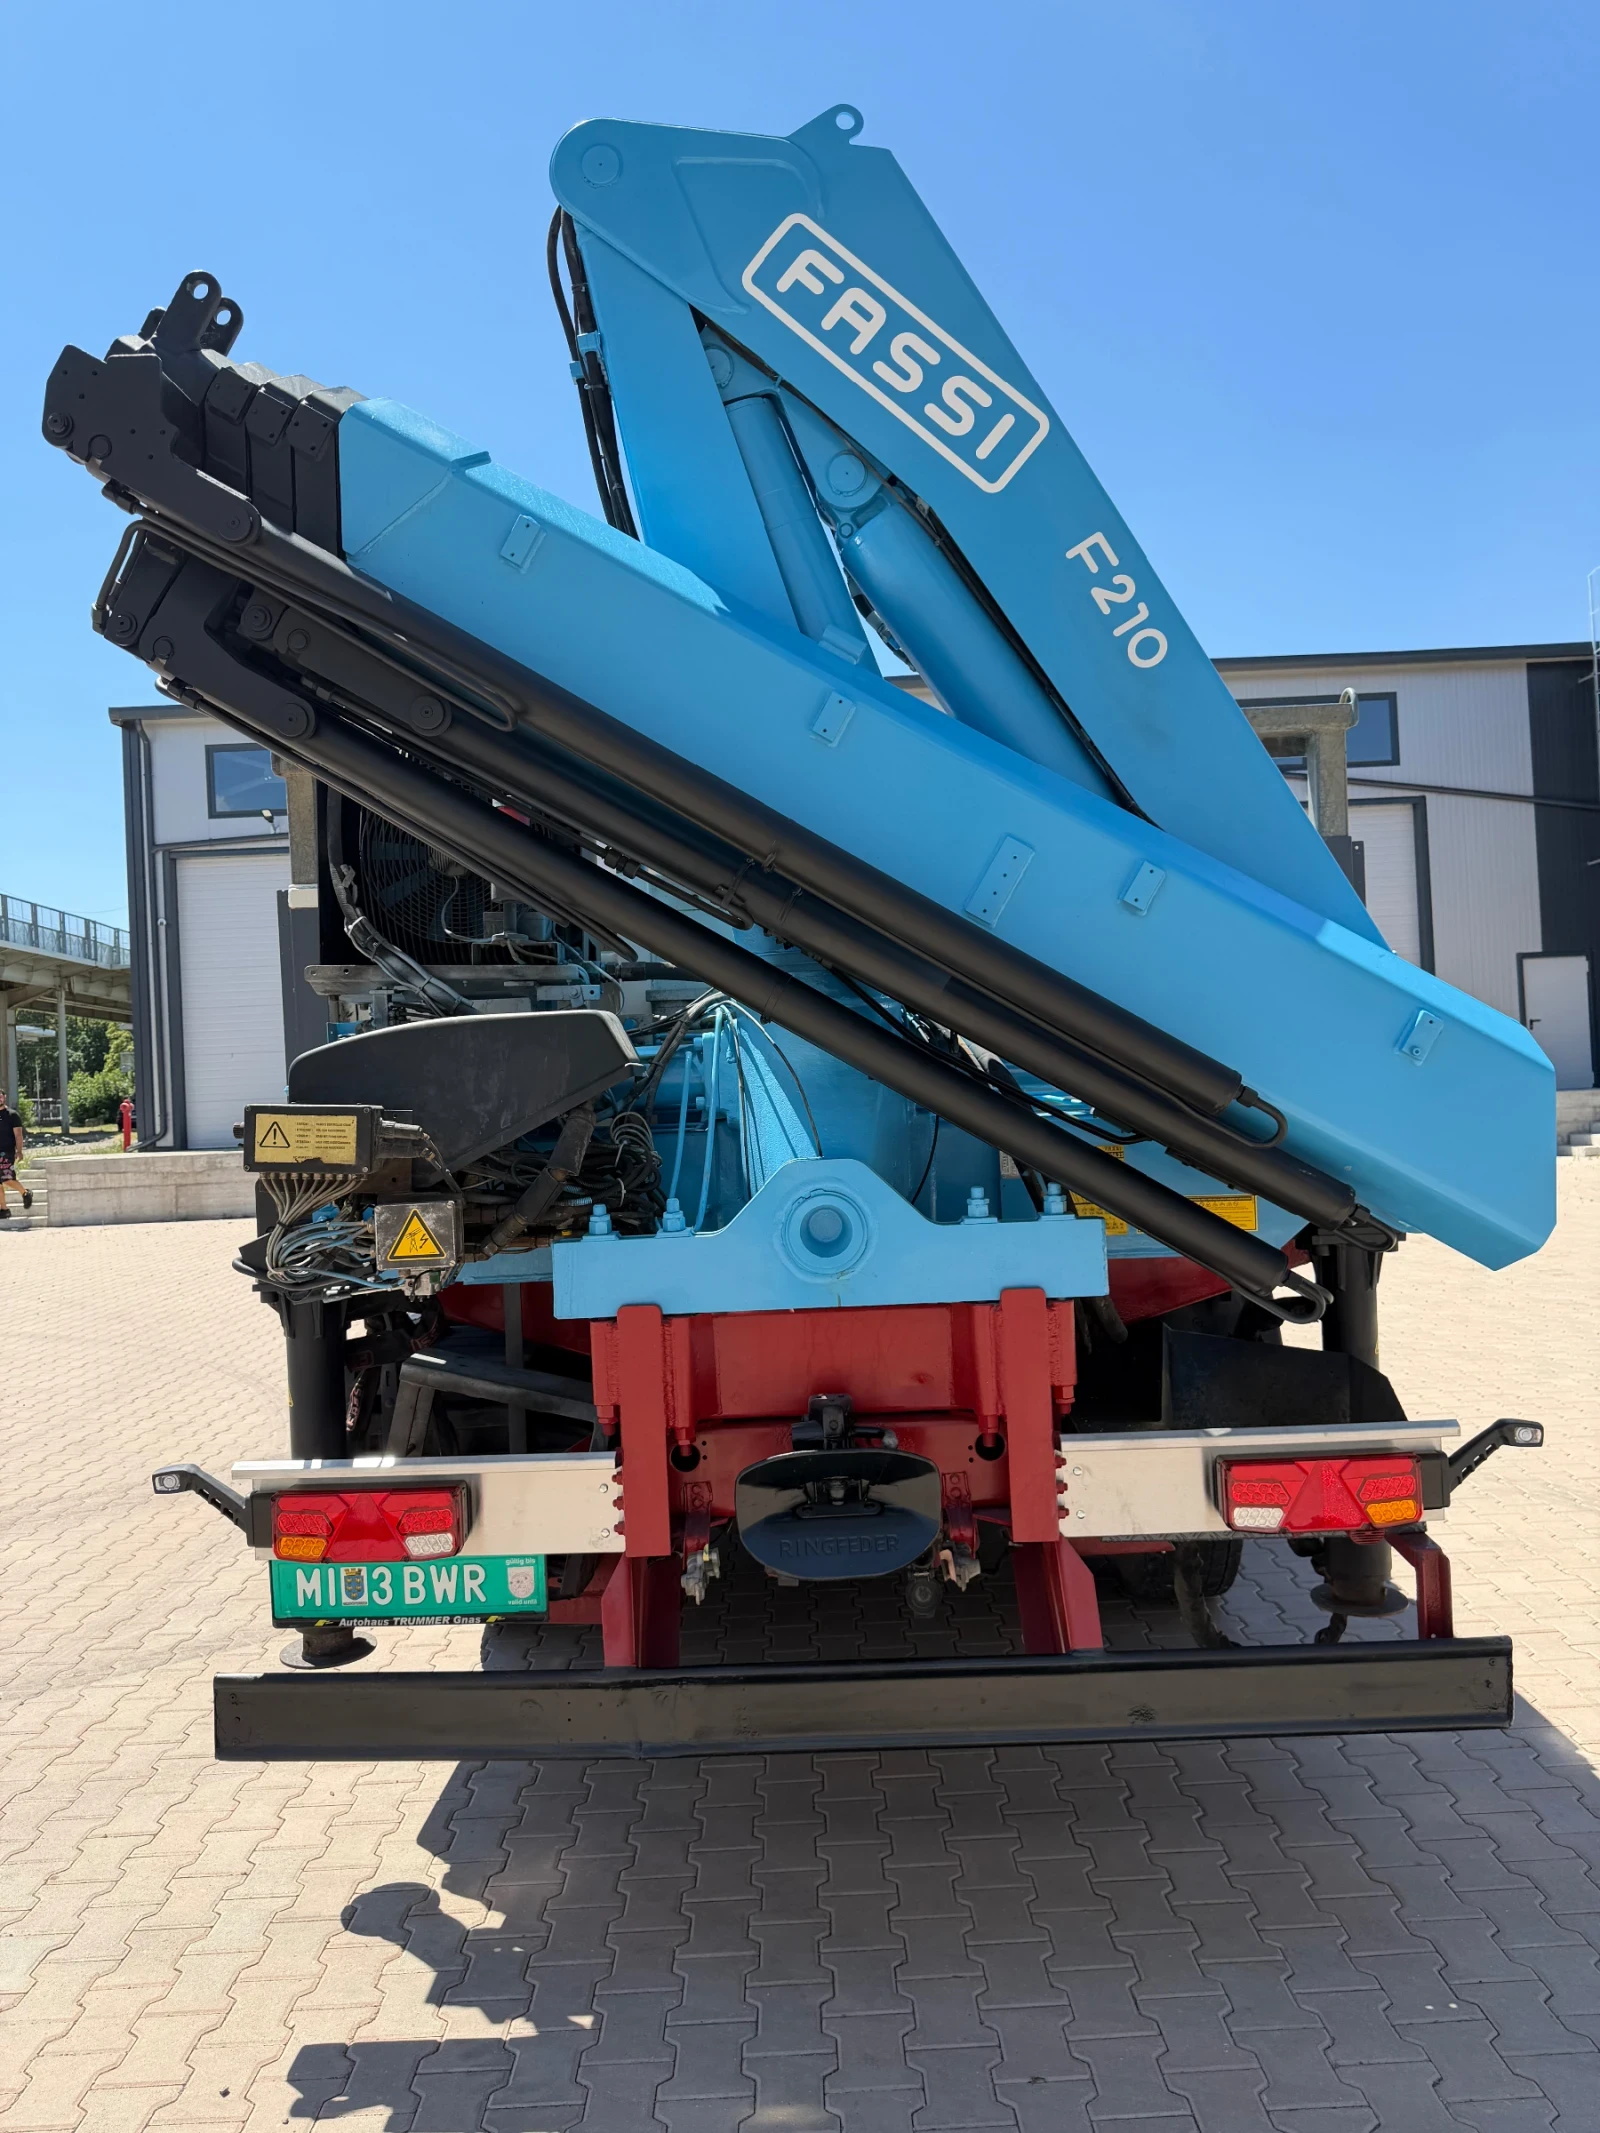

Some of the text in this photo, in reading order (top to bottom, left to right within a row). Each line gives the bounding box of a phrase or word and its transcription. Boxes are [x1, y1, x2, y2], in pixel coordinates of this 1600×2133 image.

[776, 249, 1016, 460] FASSI
[1065, 531, 1168, 668] F210
[779, 1533, 901, 1559] RINGFEDER
[296, 1564, 487, 1607] MI 3 BWR
[507, 1598, 523, 1606] valid
[339, 1615, 482, 1627] Autohaus TRUMMER Gnas
